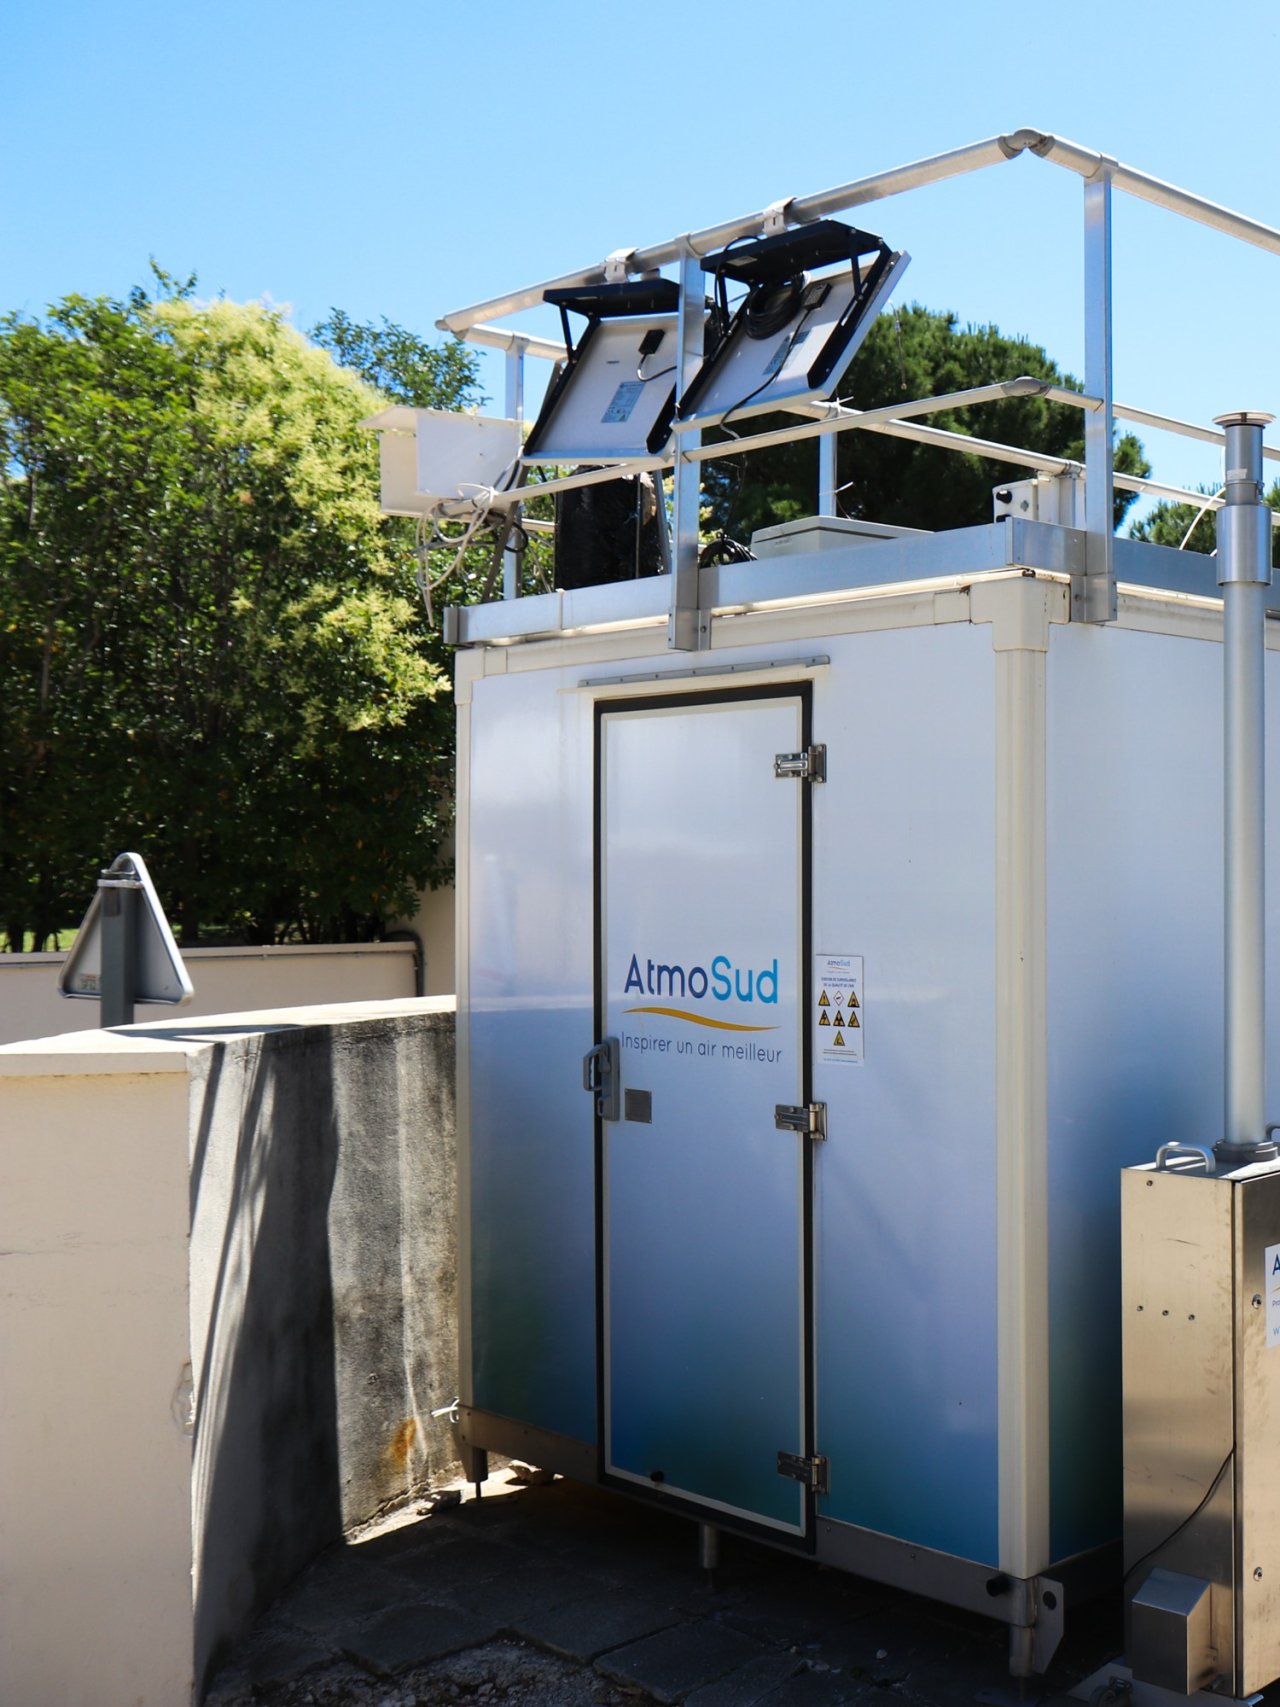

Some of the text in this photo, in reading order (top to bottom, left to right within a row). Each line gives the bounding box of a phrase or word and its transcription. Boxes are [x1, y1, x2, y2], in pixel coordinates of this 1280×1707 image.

[624, 953, 778, 1004] AtmoSud
[621, 1031, 783, 1063] Inspirer un air meilleur
